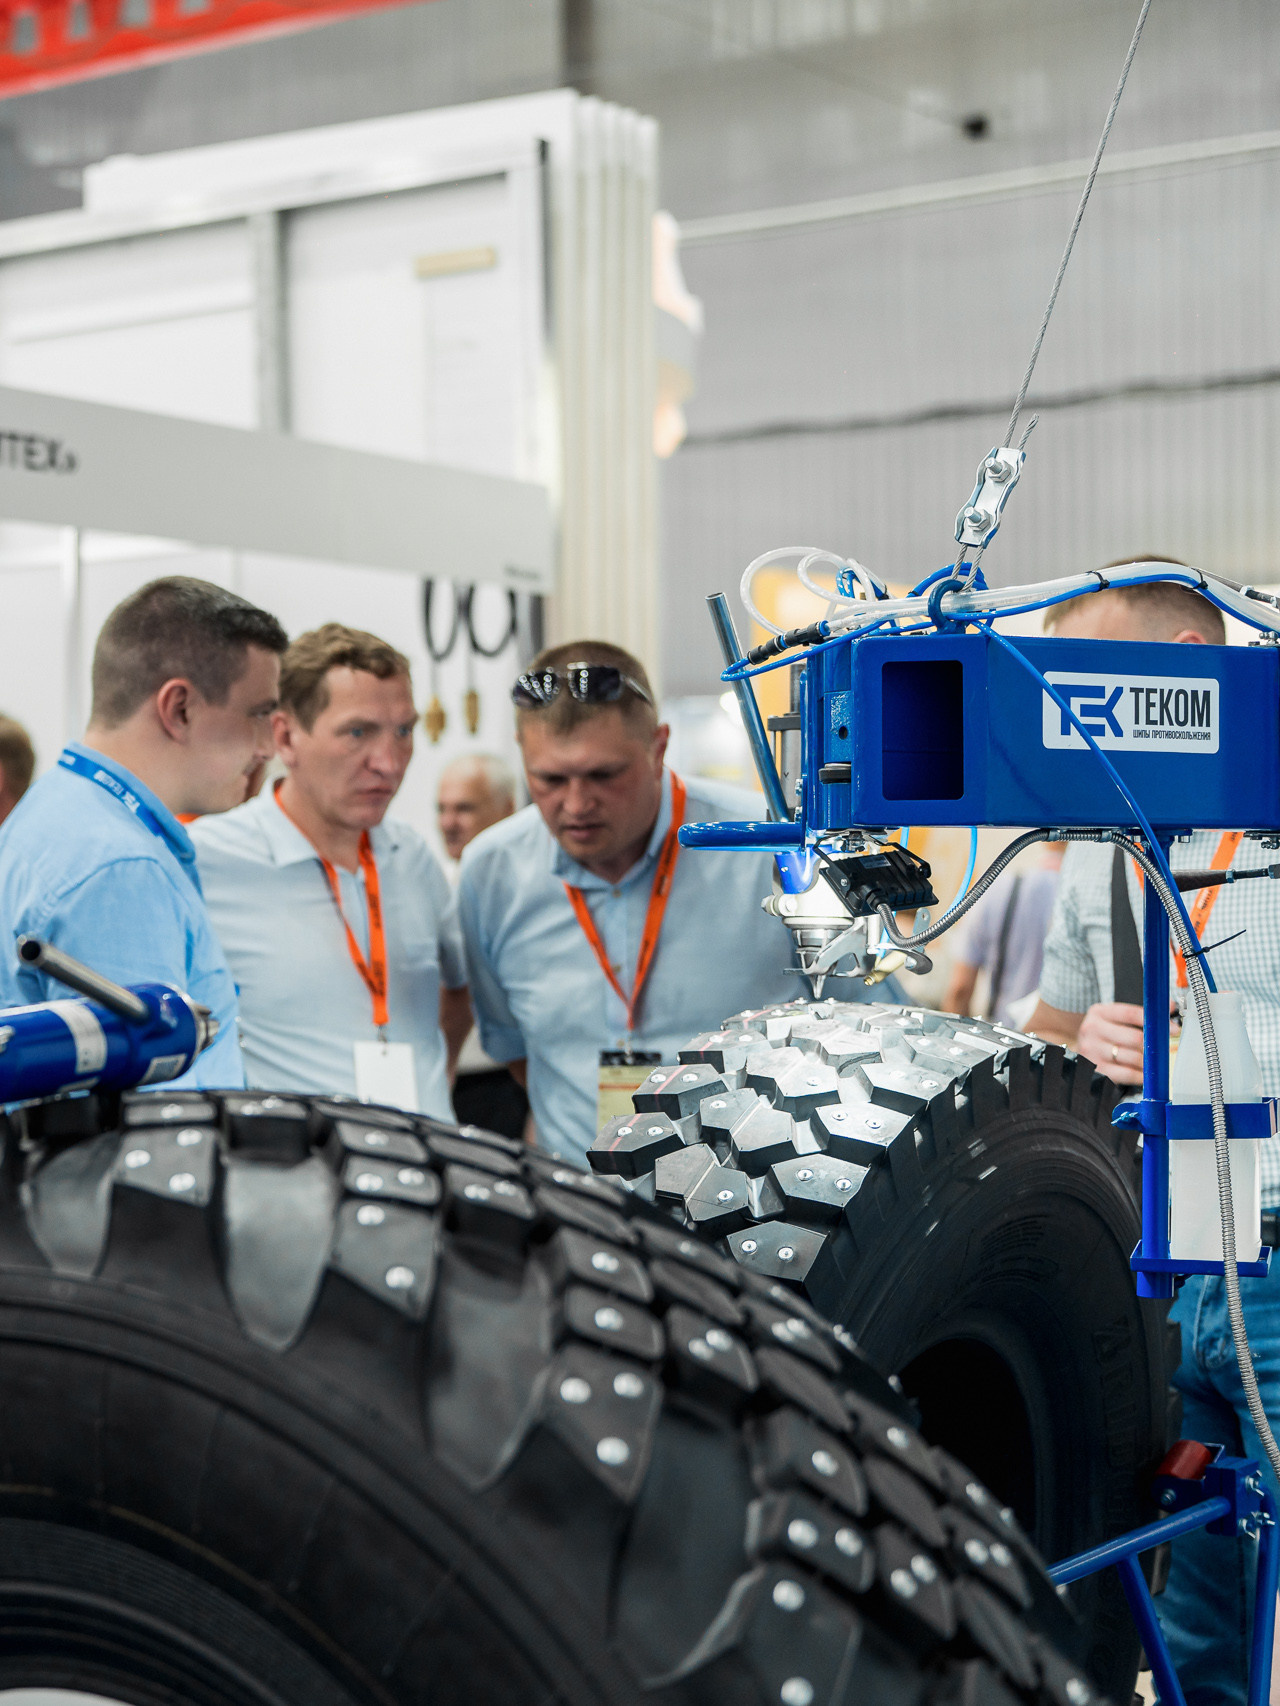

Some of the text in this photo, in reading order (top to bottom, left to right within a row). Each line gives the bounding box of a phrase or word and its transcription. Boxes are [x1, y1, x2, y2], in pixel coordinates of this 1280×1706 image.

[1129, 686, 1211, 728] ТЕКОМ
[1132, 729, 1211, 741] ШИПЫ ПРОТИВОСКОЛЬЖЕНИЯ
